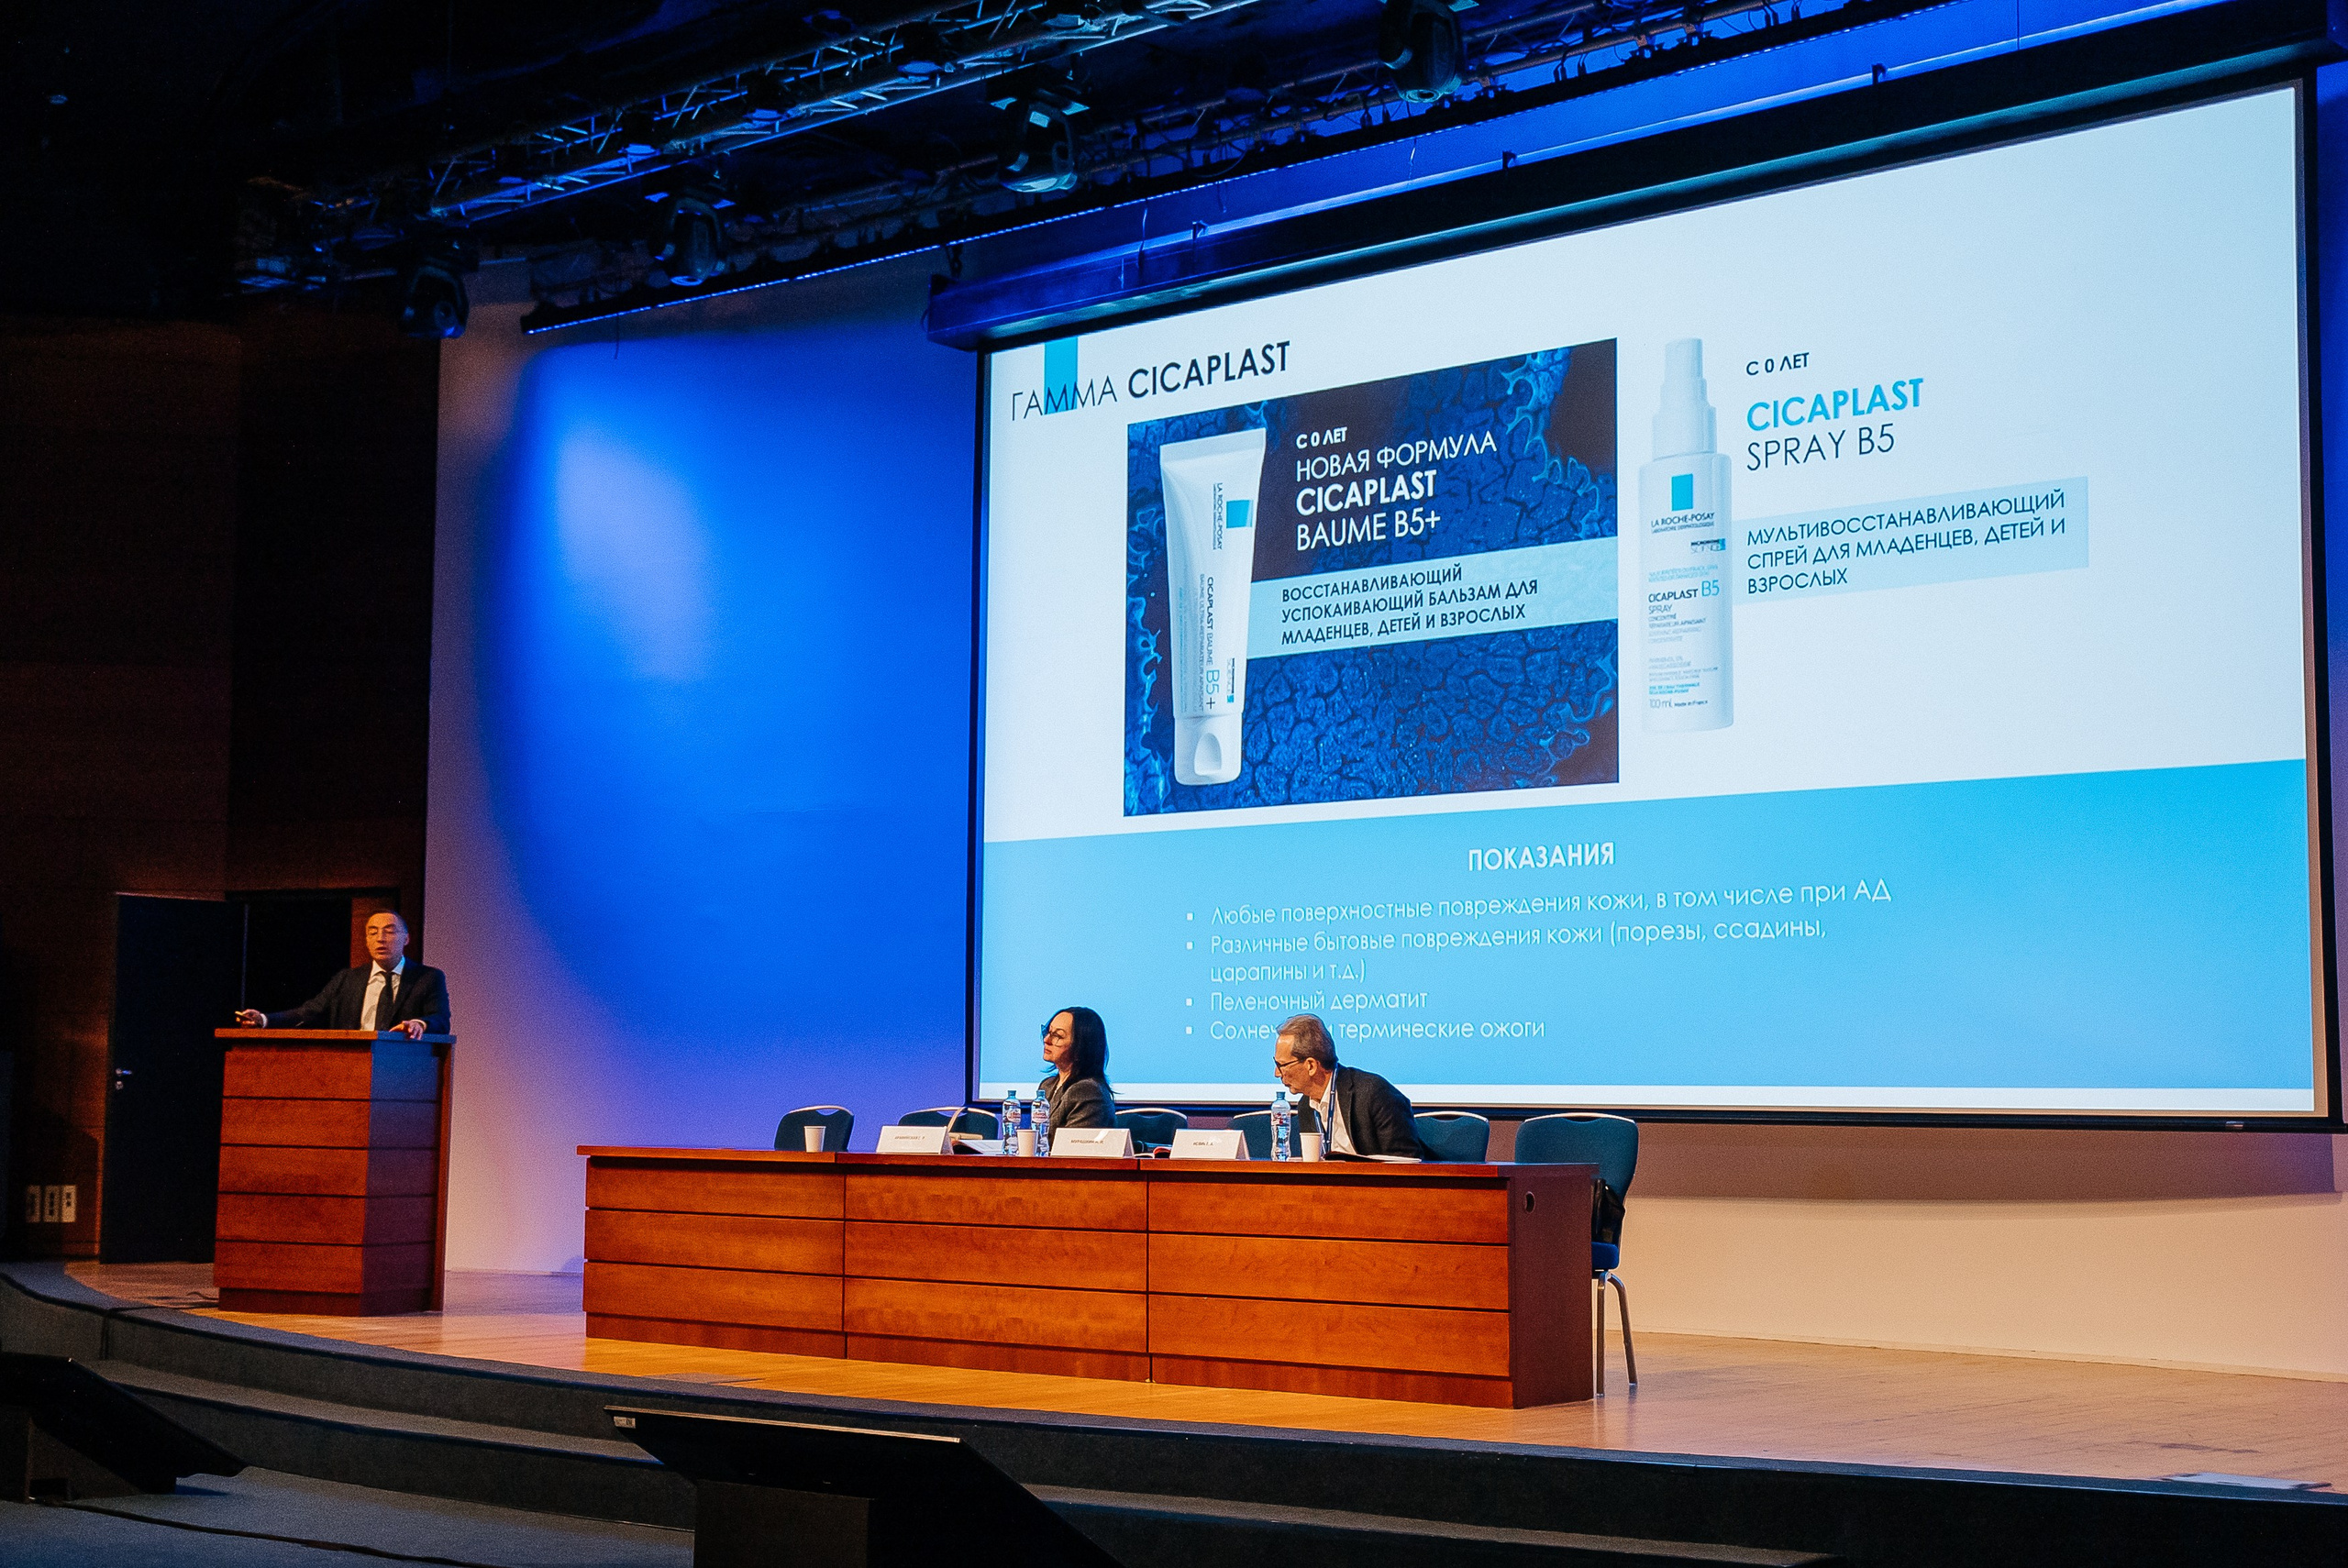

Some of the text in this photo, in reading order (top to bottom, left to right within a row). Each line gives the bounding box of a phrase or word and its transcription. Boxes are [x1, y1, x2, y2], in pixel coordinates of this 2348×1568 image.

[1012, 341, 1290, 421] ГАММА CICAPLAST
[1779, 352, 1810, 370] ЛЕТ
[1746, 378, 1924, 431] CICAPLAST
[1297, 430, 1497, 482] НОВАЯ ФОРМУЛА
[1324, 427, 1347, 445] ЛЕТ
[1746, 424, 1895, 470] SPRAY B5
[1297, 470, 1436, 514] CICAPLAST
[1297, 507, 1441, 550] BAUME B5+
[1747, 489, 2066, 546] МУЛЬТИВОССТАНАВЛИВАЮЩИЙ
[1747, 540, 1809, 569] СПРЕЙ
[1813, 543, 1850, 565] ДЛЯ
[1856, 530, 1978, 559] МЛАДЕНЦЕВ,
[1984, 517, 2044, 545] ДЕТЕЙ
[2052, 518, 2066, 536] И
[1281, 579, 1538, 624] УСПОКАИВАЮЩИЙ БАЛЬЗАМ ДЛЯ
[1282, 563, 1463, 602] ВОССТАНАВЛИВАЮЩИЙ
[1701, 580, 1720, 597] B5
[1747, 569, 1848, 594] ВЗРОСЛЫХ
[1281, 604, 1525, 646] МЛАДЕНЦЕВ, ДЕТЕЙ И ВЗРОСЛЫХ
[1468, 842, 1615, 872] ПОКАЗАНИЯ
[1211, 878, 1891, 926] Любые поверхностные повреждения кожи, в том числе при АД
[1211, 916, 1826, 955] Различные бытовые повреждения кожи (порезы, ссадины,
[1211, 962, 1307, 985] царапины
[1312, 965, 1324, 979] и
[1211, 988, 1428, 1012] Пеленочный дерматит
[1338, 1020, 1473, 1043] термические
[1480, 1017, 1545, 1041] ожоги
